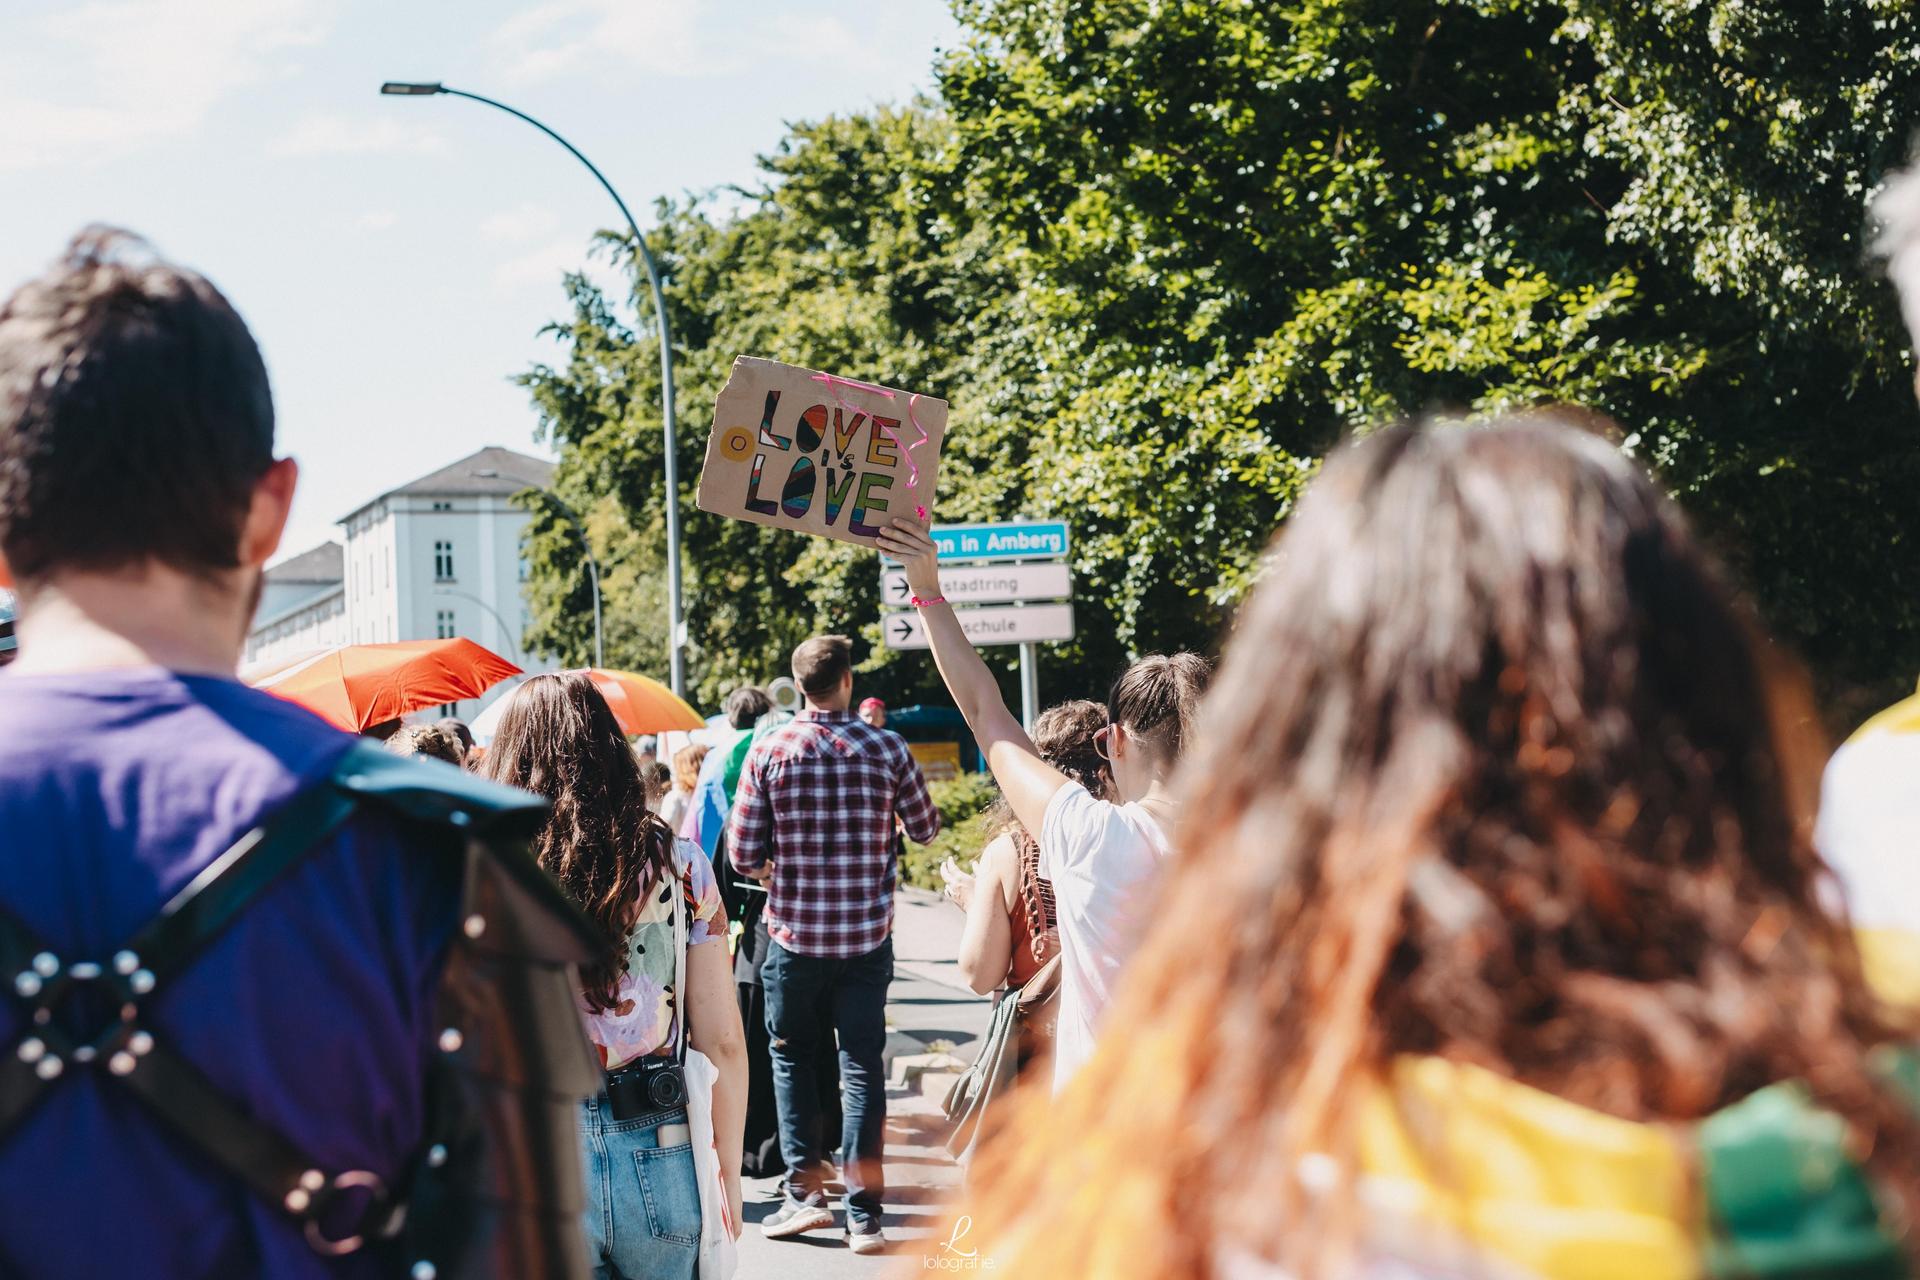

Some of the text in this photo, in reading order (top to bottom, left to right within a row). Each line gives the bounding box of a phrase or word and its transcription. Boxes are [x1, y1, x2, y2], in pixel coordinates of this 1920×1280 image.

[758, 390, 901, 468] LOVE
[745, 453, 895, 538] LOVE
[961, 533, 980, 553] in
[986, 531, 1062, 551] Amberg
[943, 577, 1019, 594] stadtring
[963, 618, 1017, 635] schule
